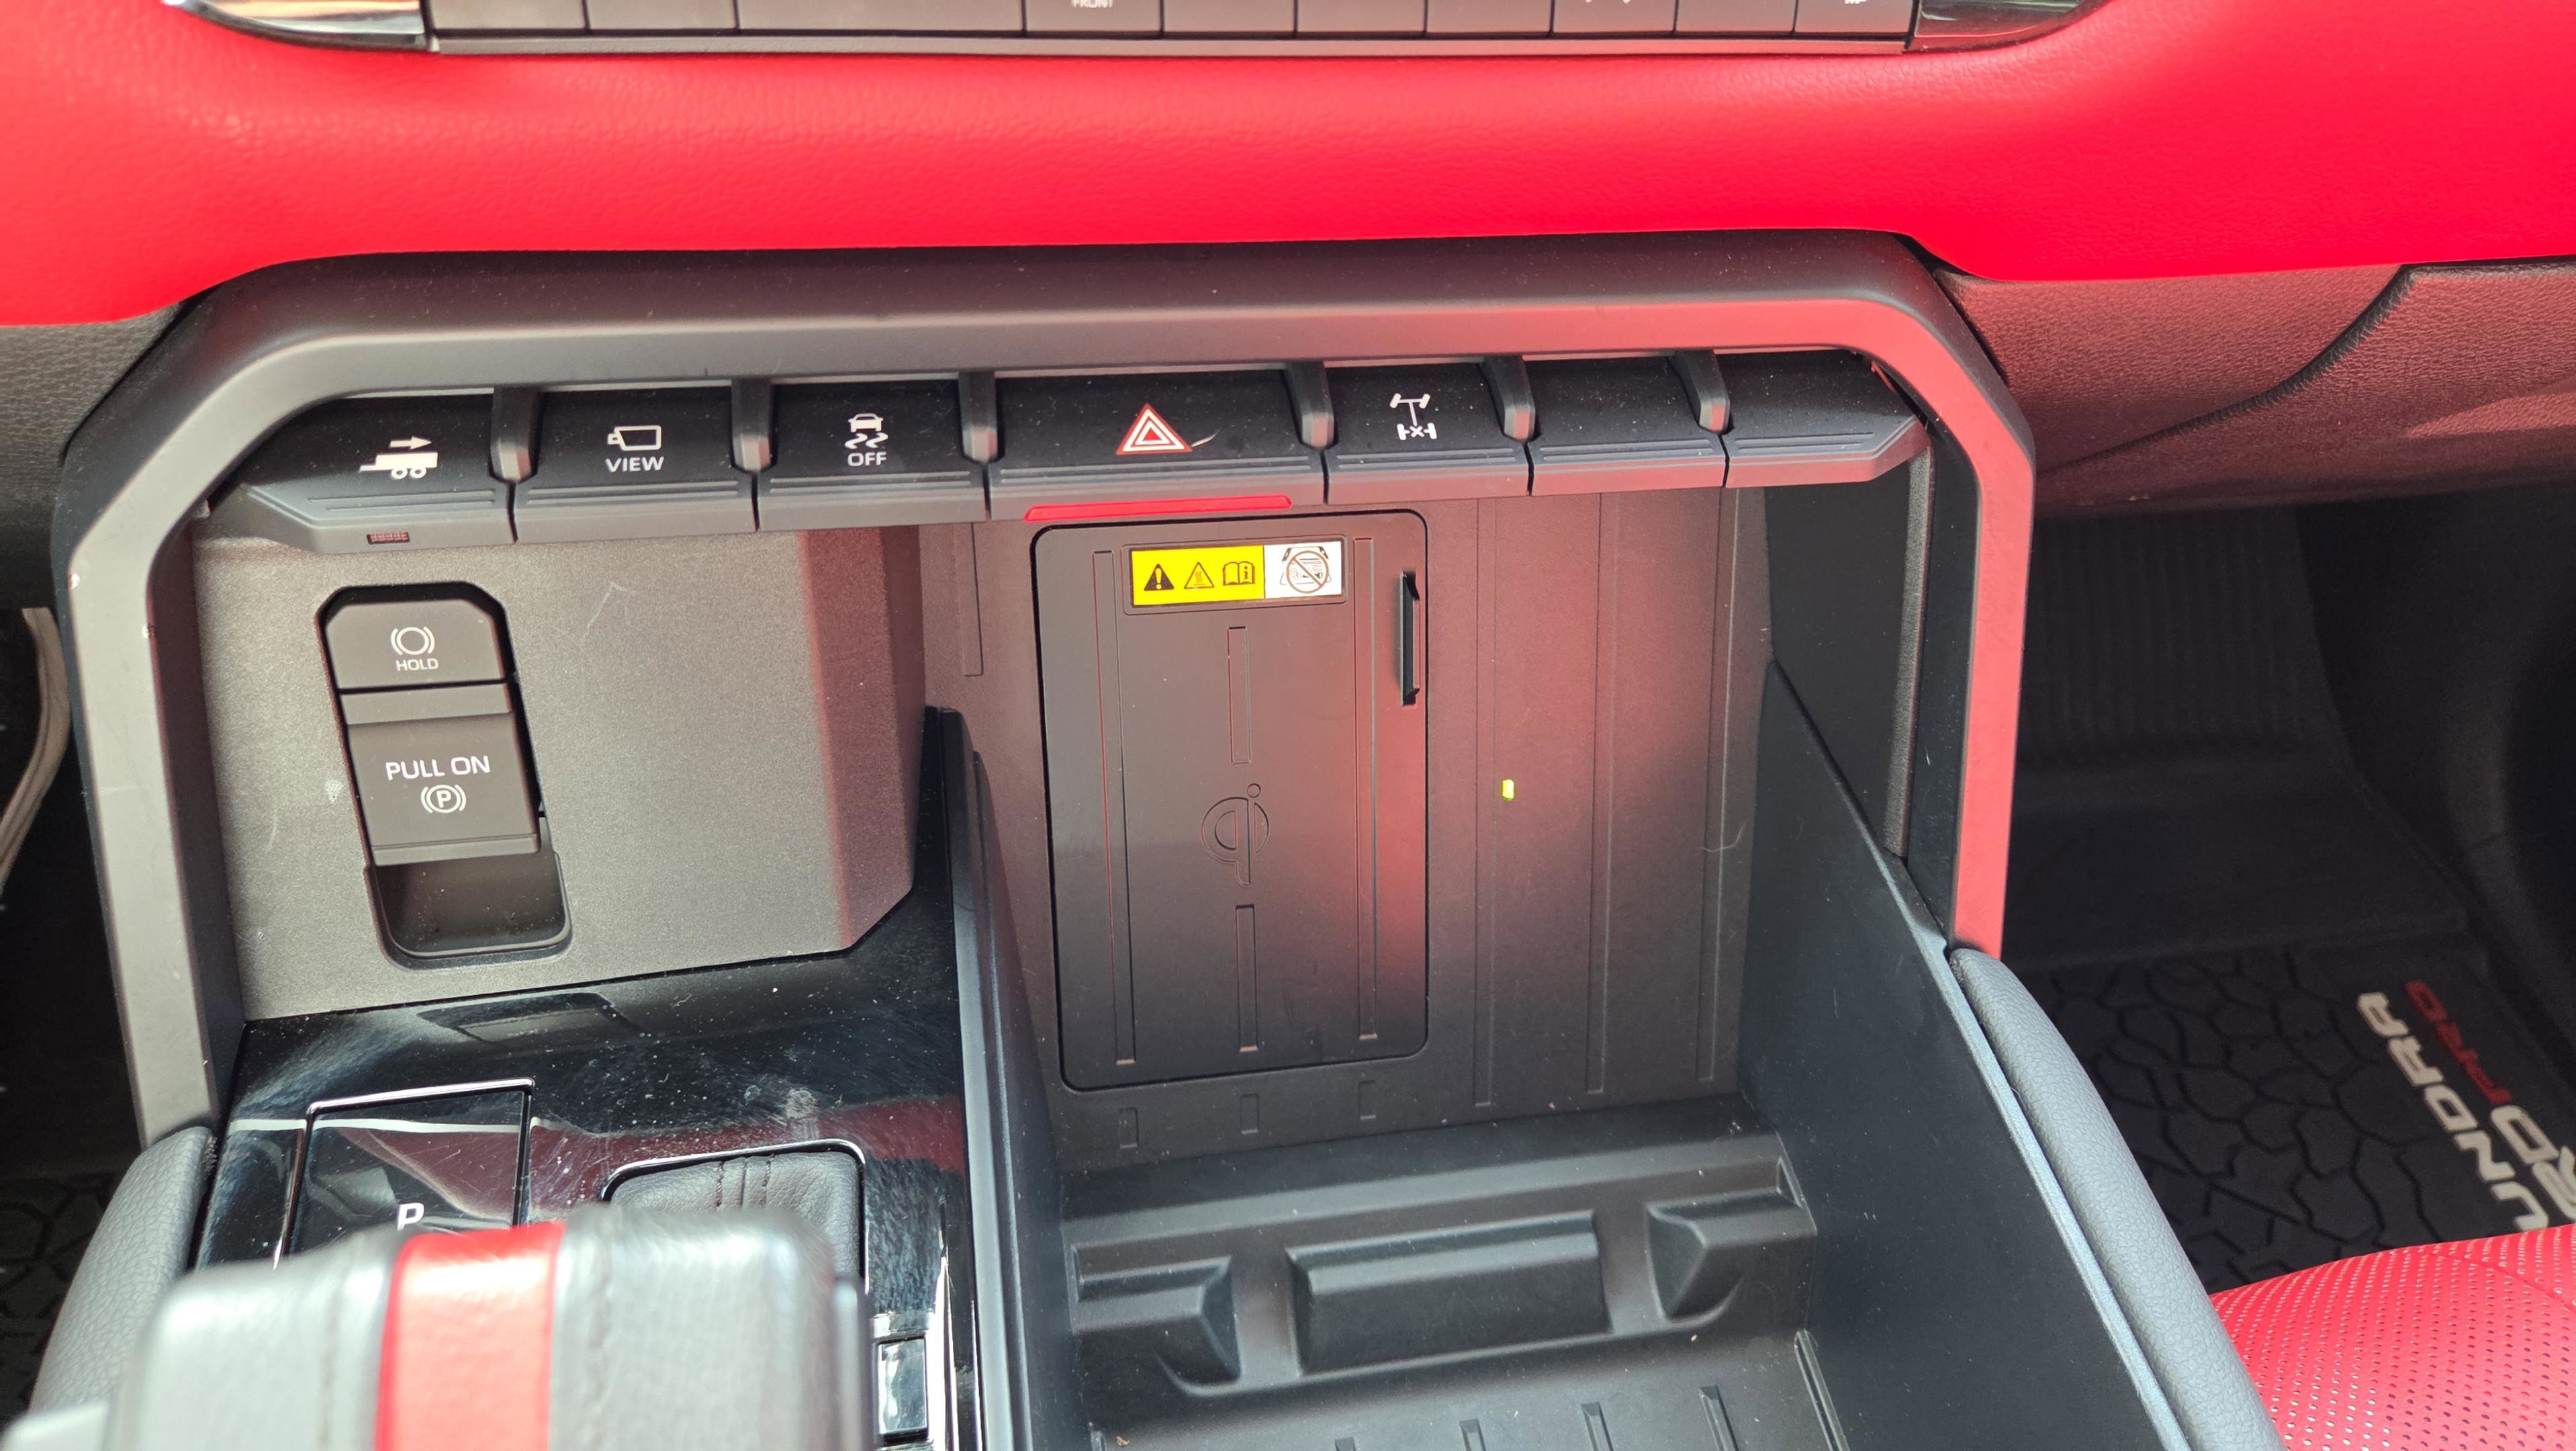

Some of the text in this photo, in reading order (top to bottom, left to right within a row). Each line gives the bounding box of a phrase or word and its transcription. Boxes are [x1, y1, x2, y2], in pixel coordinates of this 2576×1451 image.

[605, 456, 664, 473] VIEW
[847, 451, 887, 467] OFF
[396, 658, 439, 672] HOLD
[385, 754, 491, 781] PULL ON
[2356, 991, 2549, 1232] UNDRA
[397, 1202, 425, 1231] P
